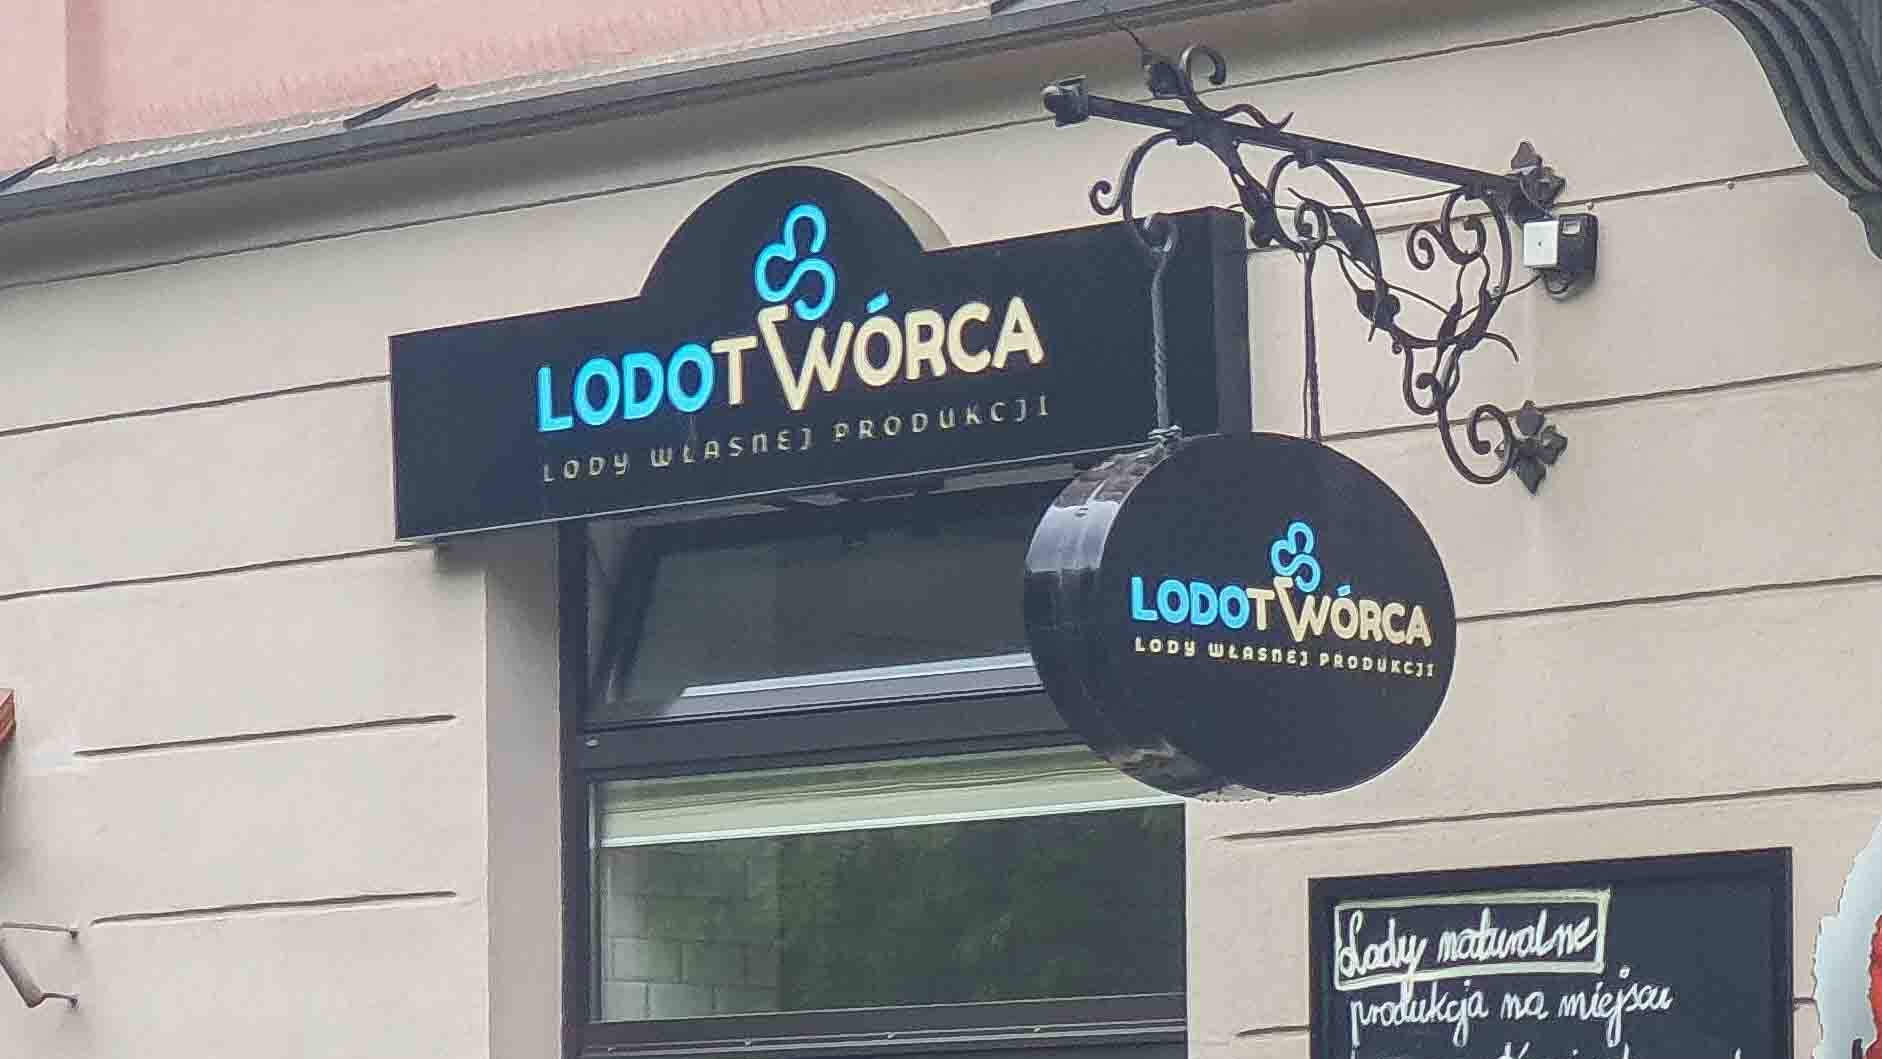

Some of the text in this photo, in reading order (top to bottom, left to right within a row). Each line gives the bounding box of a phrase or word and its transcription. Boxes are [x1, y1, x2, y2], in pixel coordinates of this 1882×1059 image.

[536, 293, 1045, 433] LODOTWÓRCA
[543, 452, 630, 483] LODY
[832, 394, 1049, 441] PRODUKCJI
[1130, 576, 1432, 647] LODOTWÓRCA
[1135, 636, 1434, 677] LODY WŁASNEJ PRODUKCJI
[1338, 907, 1597, 1000] Lody naturalne
[1350, 966, 1673, 1048] produkcja na miejscu
